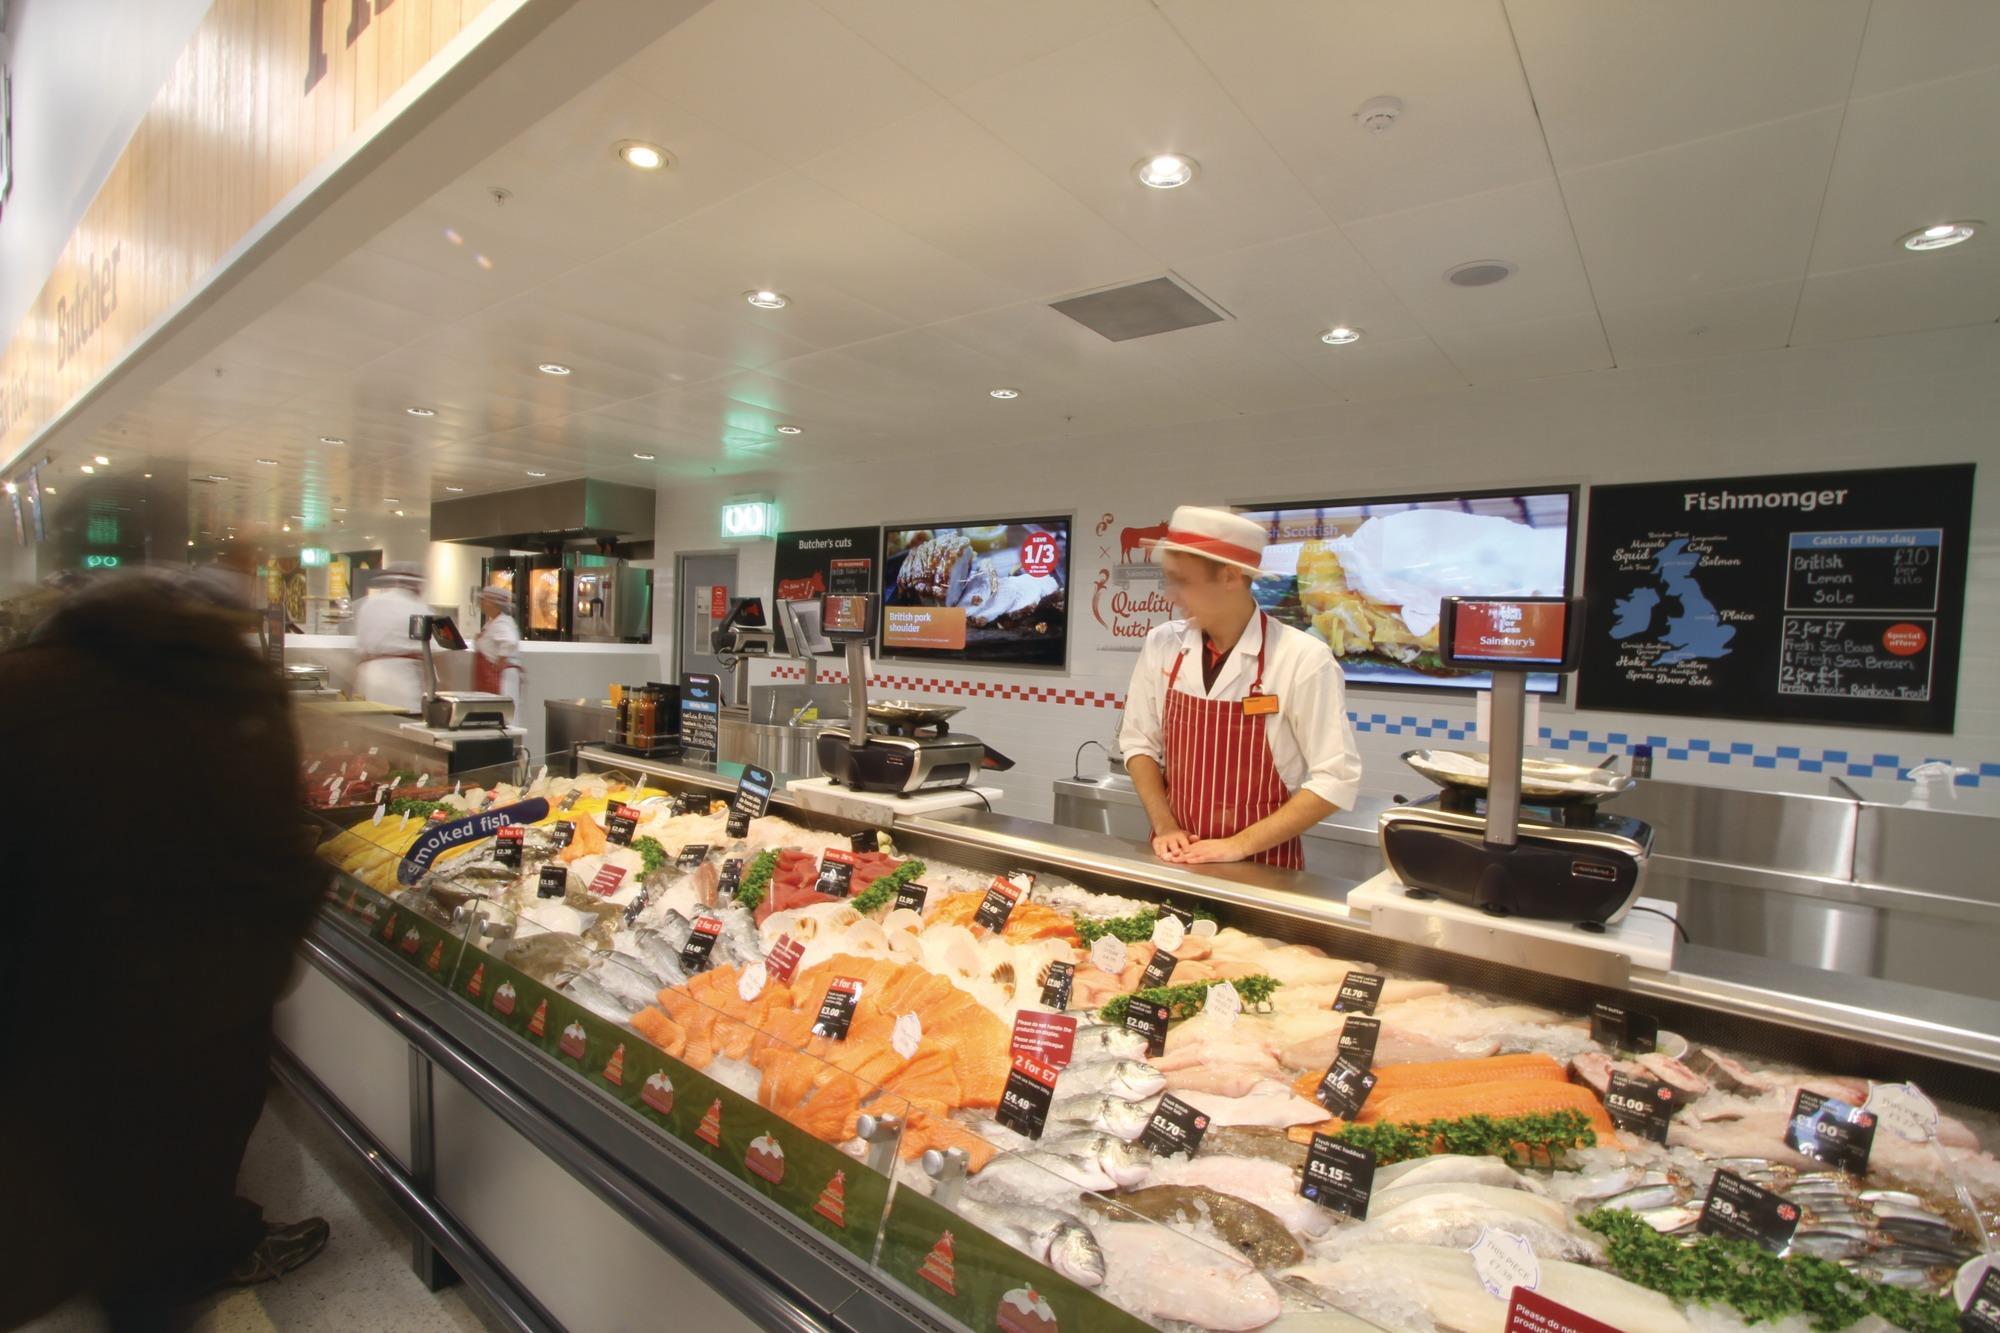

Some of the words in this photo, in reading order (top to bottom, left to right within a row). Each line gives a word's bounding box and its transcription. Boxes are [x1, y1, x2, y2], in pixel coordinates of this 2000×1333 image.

[57, 240, 121, 372] Butcher
[1683, 489, 1848, 512] Fishmonger
[1283, 525, 1338, 538] Scottish
[1812, 535, 1847, 545] Catch
[1850, 535, 1864, 544] of
[1866, 534, 1888, 544] the
[1890, 533, 1917, 546] day
[798, 538, 834, 550] Butcher's
[834, 538, 853, 548] cuts
[1024, 544, 1055, 564] 1/3
[1612, 548, 1650, 563] Squid
[1699, 555, 1741, 567] Salmon
[1794, 553, 1844, 571] British
[1807, 572, 1852, 585] Lemon
[1112, 591, 1174, 620] Quality
[1813, 589, 1854, 604] Sole
[889, 612, 913, 622] British
[913, 612, 932, 623] pork
[1720, 609, 1755, 621] Plaice
[889, 623, 920, 633] shoulder
[1113, 616, 1154, 638] butch
[1788, 620, 1800, 635] 2
[1801, 621, 1822, 639] for
[1823, 621, 1846, 639] £7
[1479, 636, 1536, 648] Sainsbury's
[1784, 638, 1814, 651] Fresh
[1820, 640, 1841, 653] Sea
[1844, 640, 1874, 653] Bass
[1616, 655, 1647, 667] Hake
[1795, 652, 1832, 666] Fresh
[1834, 655, 1863, 669] Sea
[1865, 656, 1914, 670] Bream
[1656, 673, 1687, 685] Dover
[1688, 675, 1712, 686] Sole
[1783, 666, 1795, 681] 2
[1795, 667, 1816, 685] for
[1850, 683, 1895, 697] Rainbow
[1897, 684, 1929, 698] Trout
[408, 821, 474, 875] smoked
[480, 812, 511, 832] fish
[832, 978, 839, 987] 2
[838, 978, 851, 989] for
[1126, 1016, 1149, 1031] £2.00
[1015, 1055, 1023, 1066] 2
[1024, 1057, 1040, 1075] for
[1042, 1069, 1056, 1082] £7
[1005, 1090, 1030, 1110] £4.49
[1608, 1093, 1644, 1112] £1.00
[1152, 1115, 1180, 1136] £1.70
[1315, 1137, 1330, 1147] Fresh
[1330, 1143, 1343, 1152] MSC
[1342, 1147, 1367, 1159] haddock
[1310, 1160, 1344, 1181] £1.15
[1720, 1175, 1739, 1188] Fresh
[1739, 1183, 1763, 1199] British
[1711, 1197, 1738, 1219] 39p
[1513, 1315, 1552, 1333] product
[1516, 1303, 1546, 1324] Please
[1547, 1319, 1559, 1330] do
